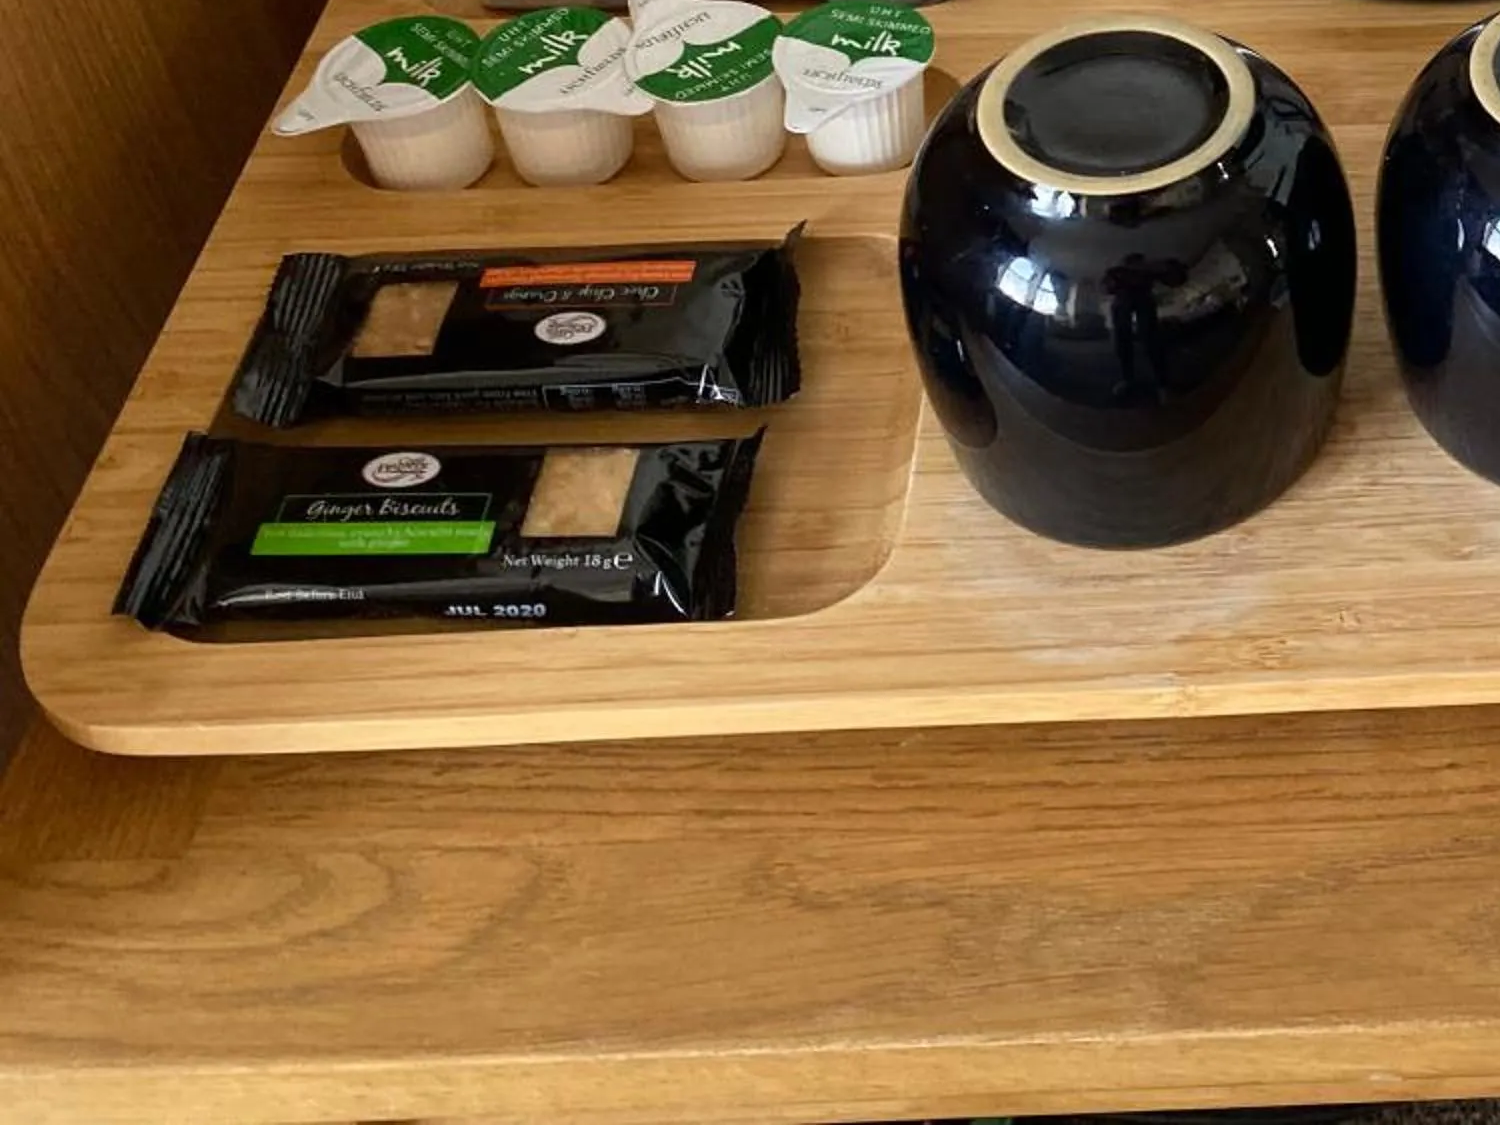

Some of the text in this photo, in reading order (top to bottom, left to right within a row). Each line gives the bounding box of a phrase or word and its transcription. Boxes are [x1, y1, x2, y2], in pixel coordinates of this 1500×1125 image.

[518, 29, 590, 75] milk
[830, 30, 902, 57] milk
[384, 46, 444, 88] milk
[665, 41, 743, 79] milk
[304, 496, 461, 522] Ginger Biscuits
[502, 554, 529, 568] Net
[530, 554, 580, 570] Weight
[445, 603, 548, 618] JUL 2020
